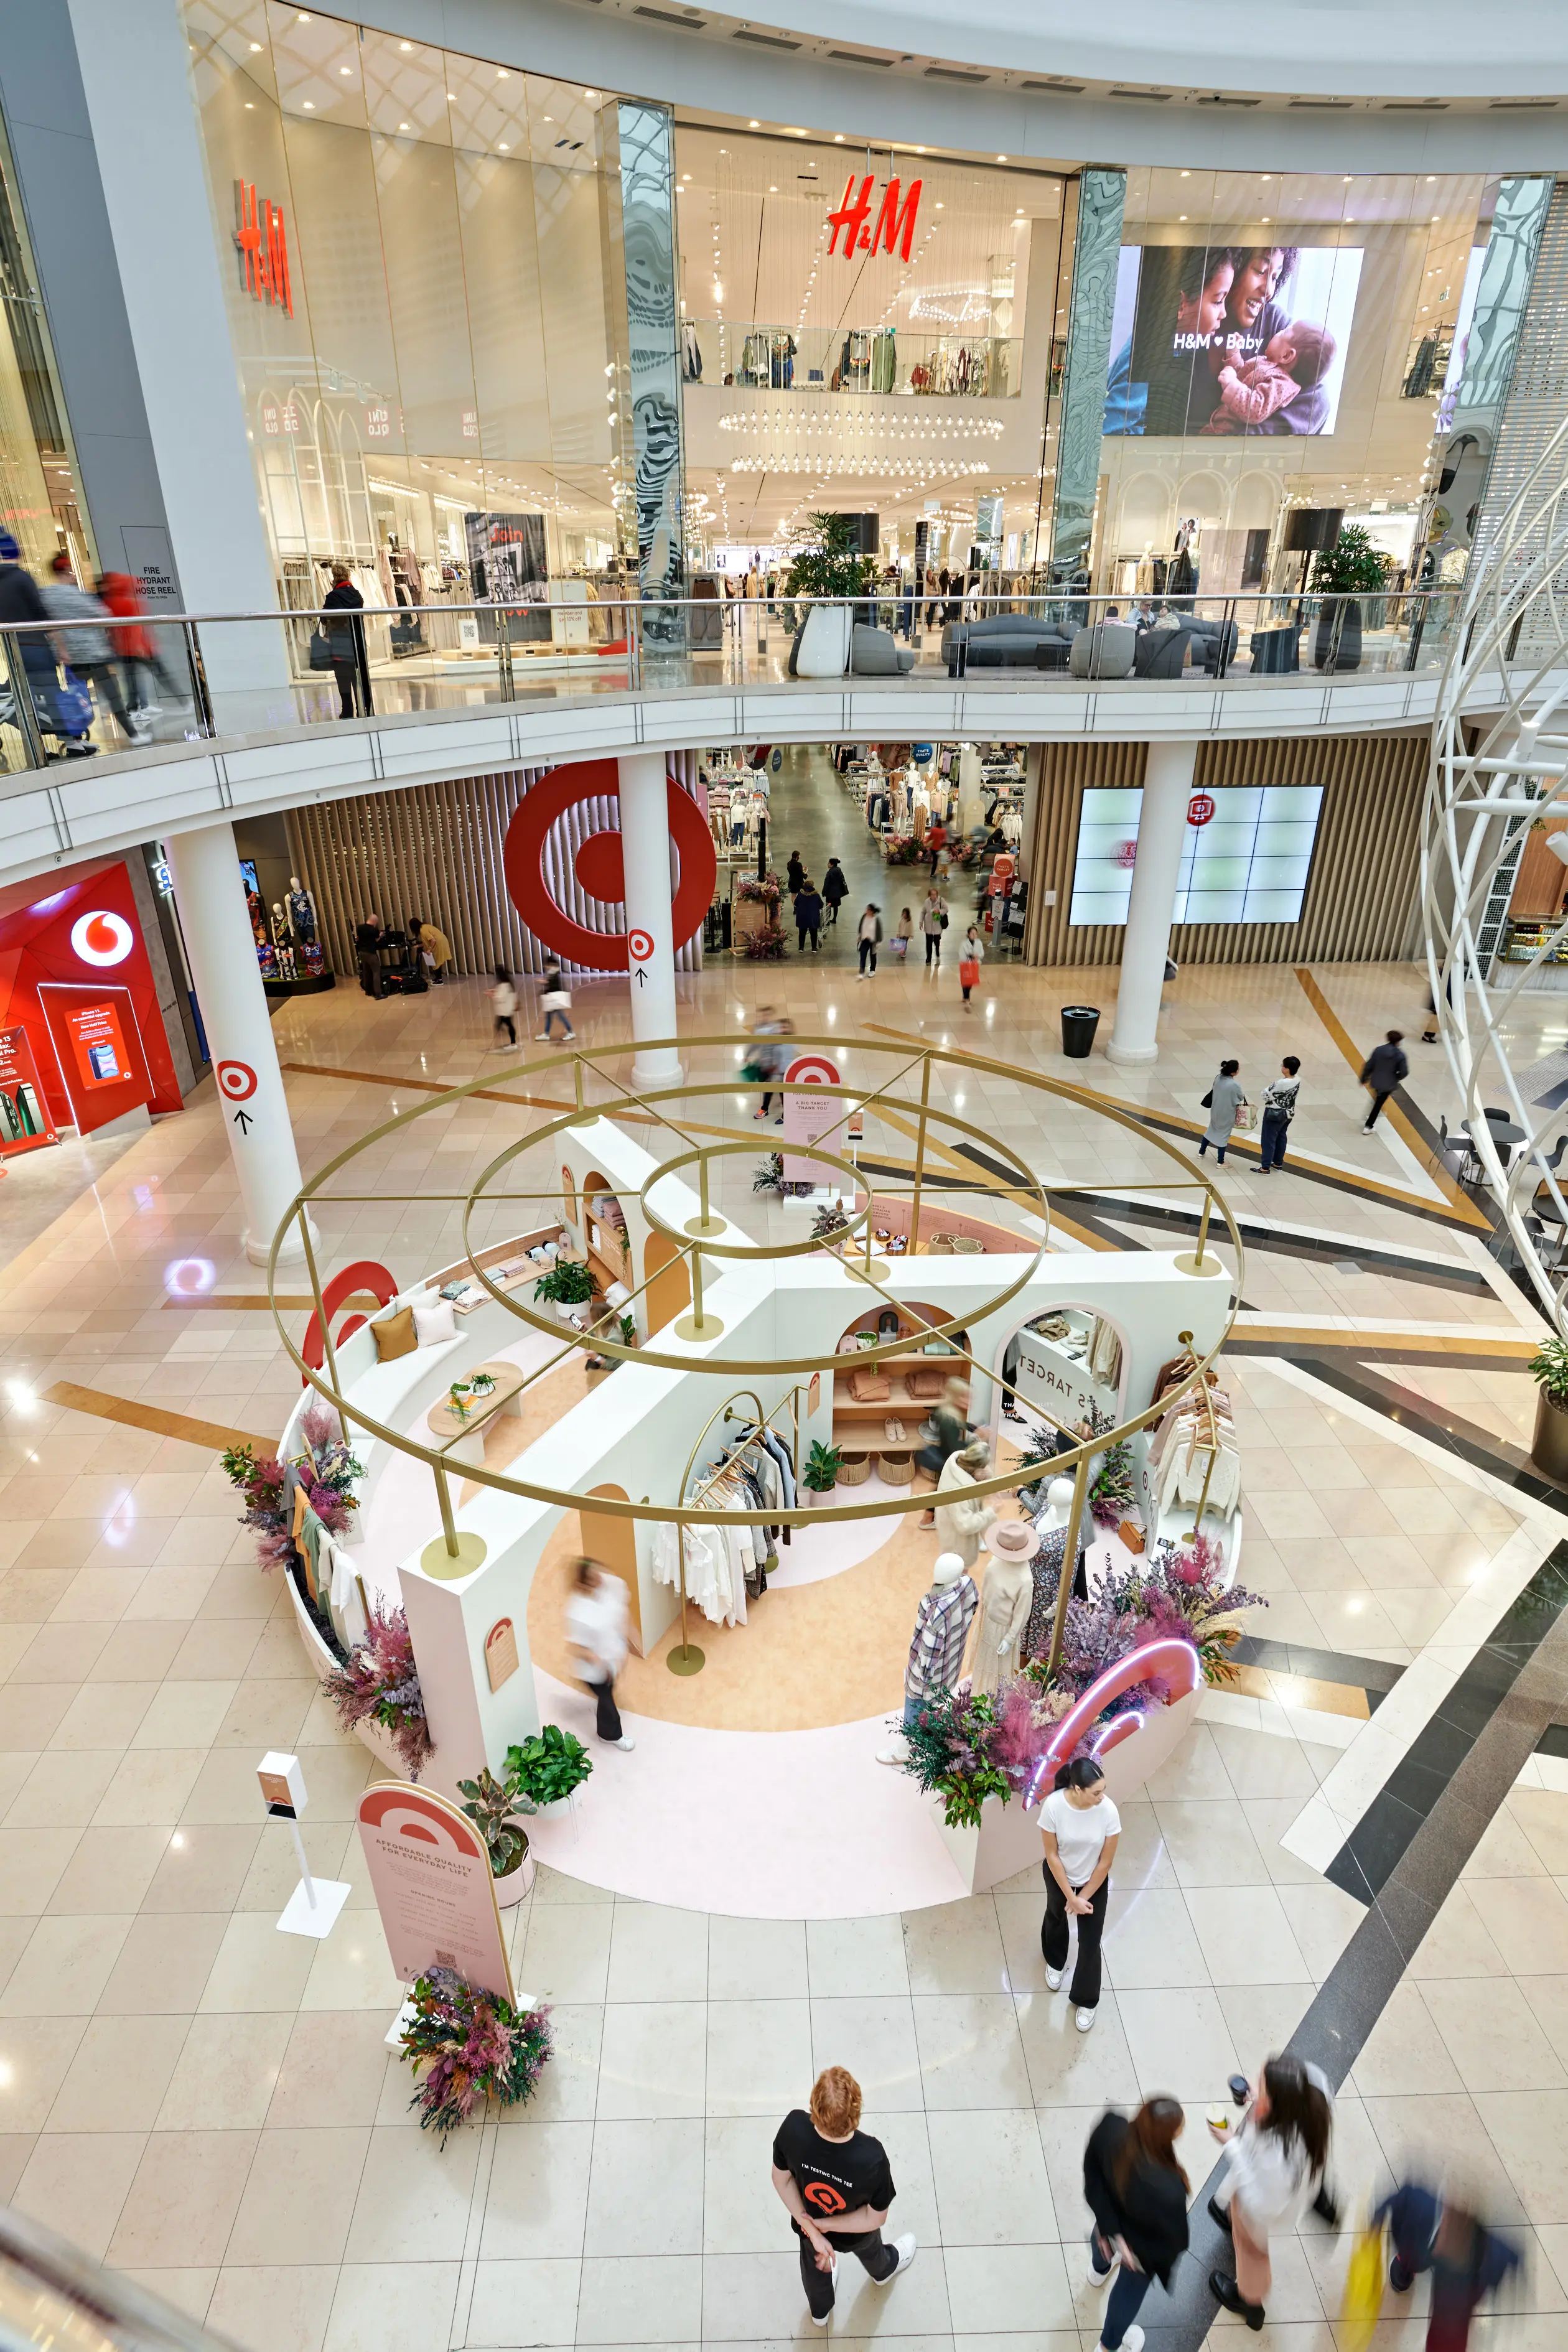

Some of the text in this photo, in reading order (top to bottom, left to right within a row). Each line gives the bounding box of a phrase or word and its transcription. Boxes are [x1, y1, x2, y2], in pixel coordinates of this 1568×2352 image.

[828, 174, 922, 263] H&M
[237, 178, 294, 320] H&M
[1174, 333, 1263, 353] H&M Baby
[490, 525, 523, 542] Join
[375, 1839, 472, 1872] AFFORDABLE QUALITY
[382, 1846, 469, 1878] FOR EVERYDAY LIFE
[410, 1890, 456, 1908] OPENING HOURS
[810, 2166, 831, 2178] TESTING
[831, 2175, 842, 2183] THIS
